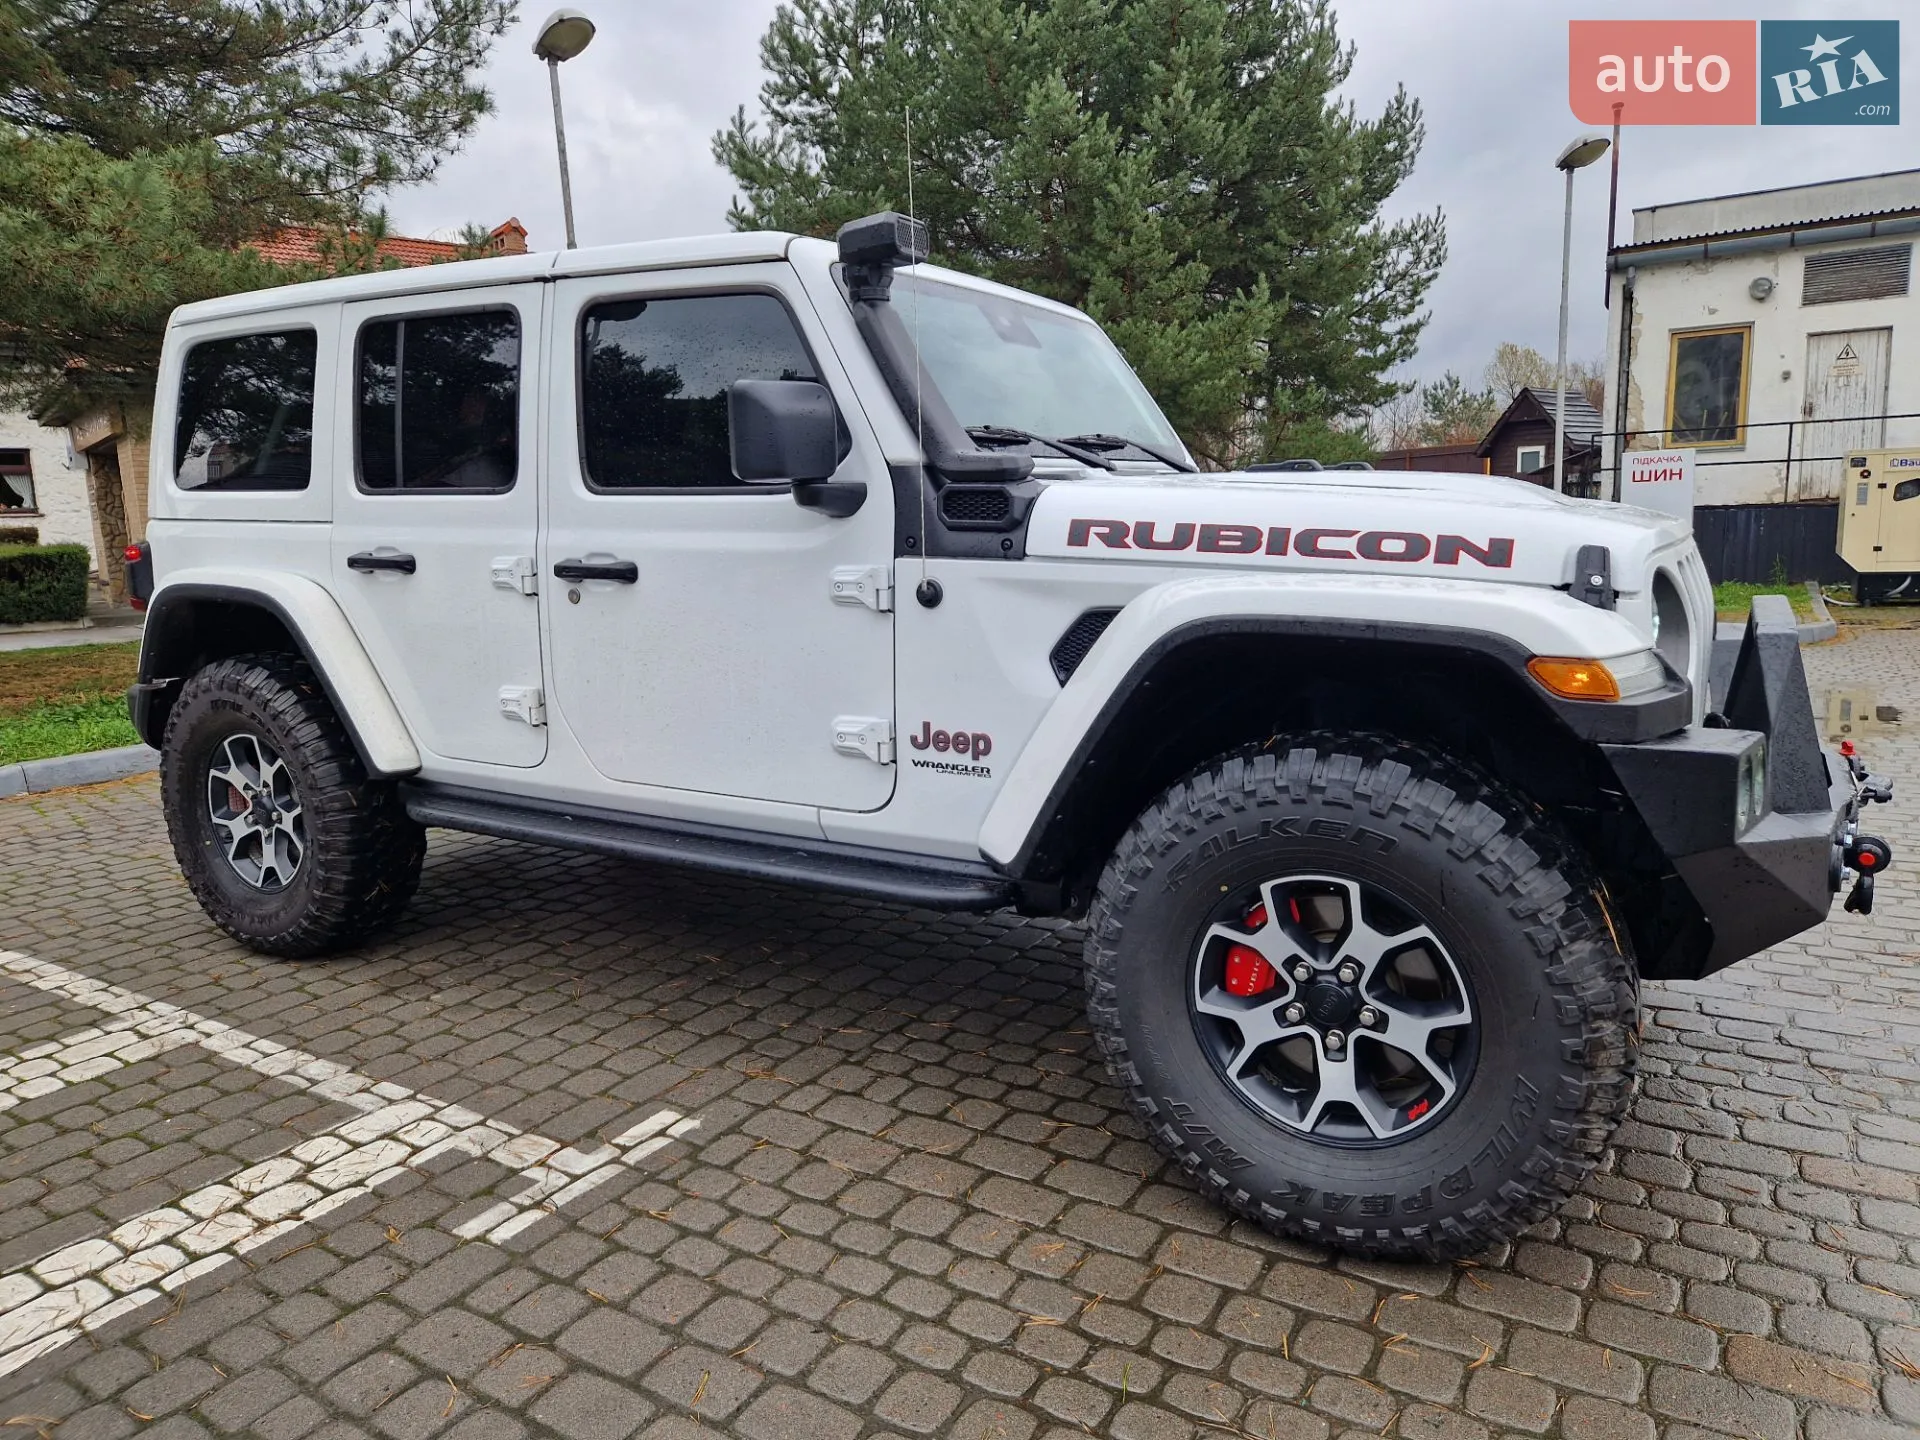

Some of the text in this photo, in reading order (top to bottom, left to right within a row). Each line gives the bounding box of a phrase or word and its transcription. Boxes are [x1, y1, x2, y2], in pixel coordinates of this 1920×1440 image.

[1632, 455, 1683, 466] ПІДКАЧКА
[1632, 467, 1683, 483] ШИН
[1066, 518, 1515, 568] RUBICON
[909, 720, 992, 761] Jeep
[911, 759, 991, 775] WRANGLER
[936, 769, 992, 779] UNLIMITED
